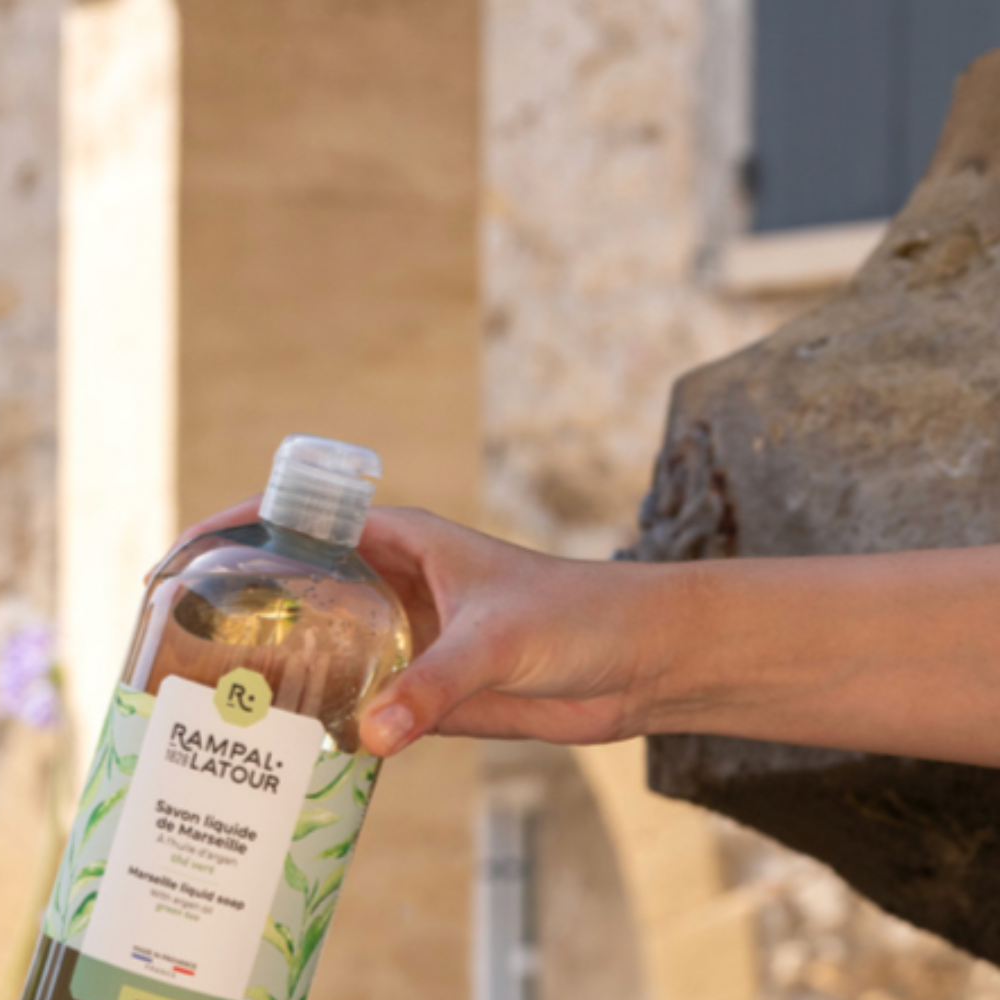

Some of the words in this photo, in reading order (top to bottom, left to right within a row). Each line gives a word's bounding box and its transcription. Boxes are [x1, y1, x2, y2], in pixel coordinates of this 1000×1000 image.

[190, 753, 280, 794] LATOUR
[155, 799, 200, 824] Savon
[203, 814, 257, 841] liquide
[156, 816, 175, 832] de
[178, 823, 248, 855] Marseille
[127, 866, 177, 890] Marseille
[180, 882, 215, 902] liquid
[217, 895, 246, 911] soap
